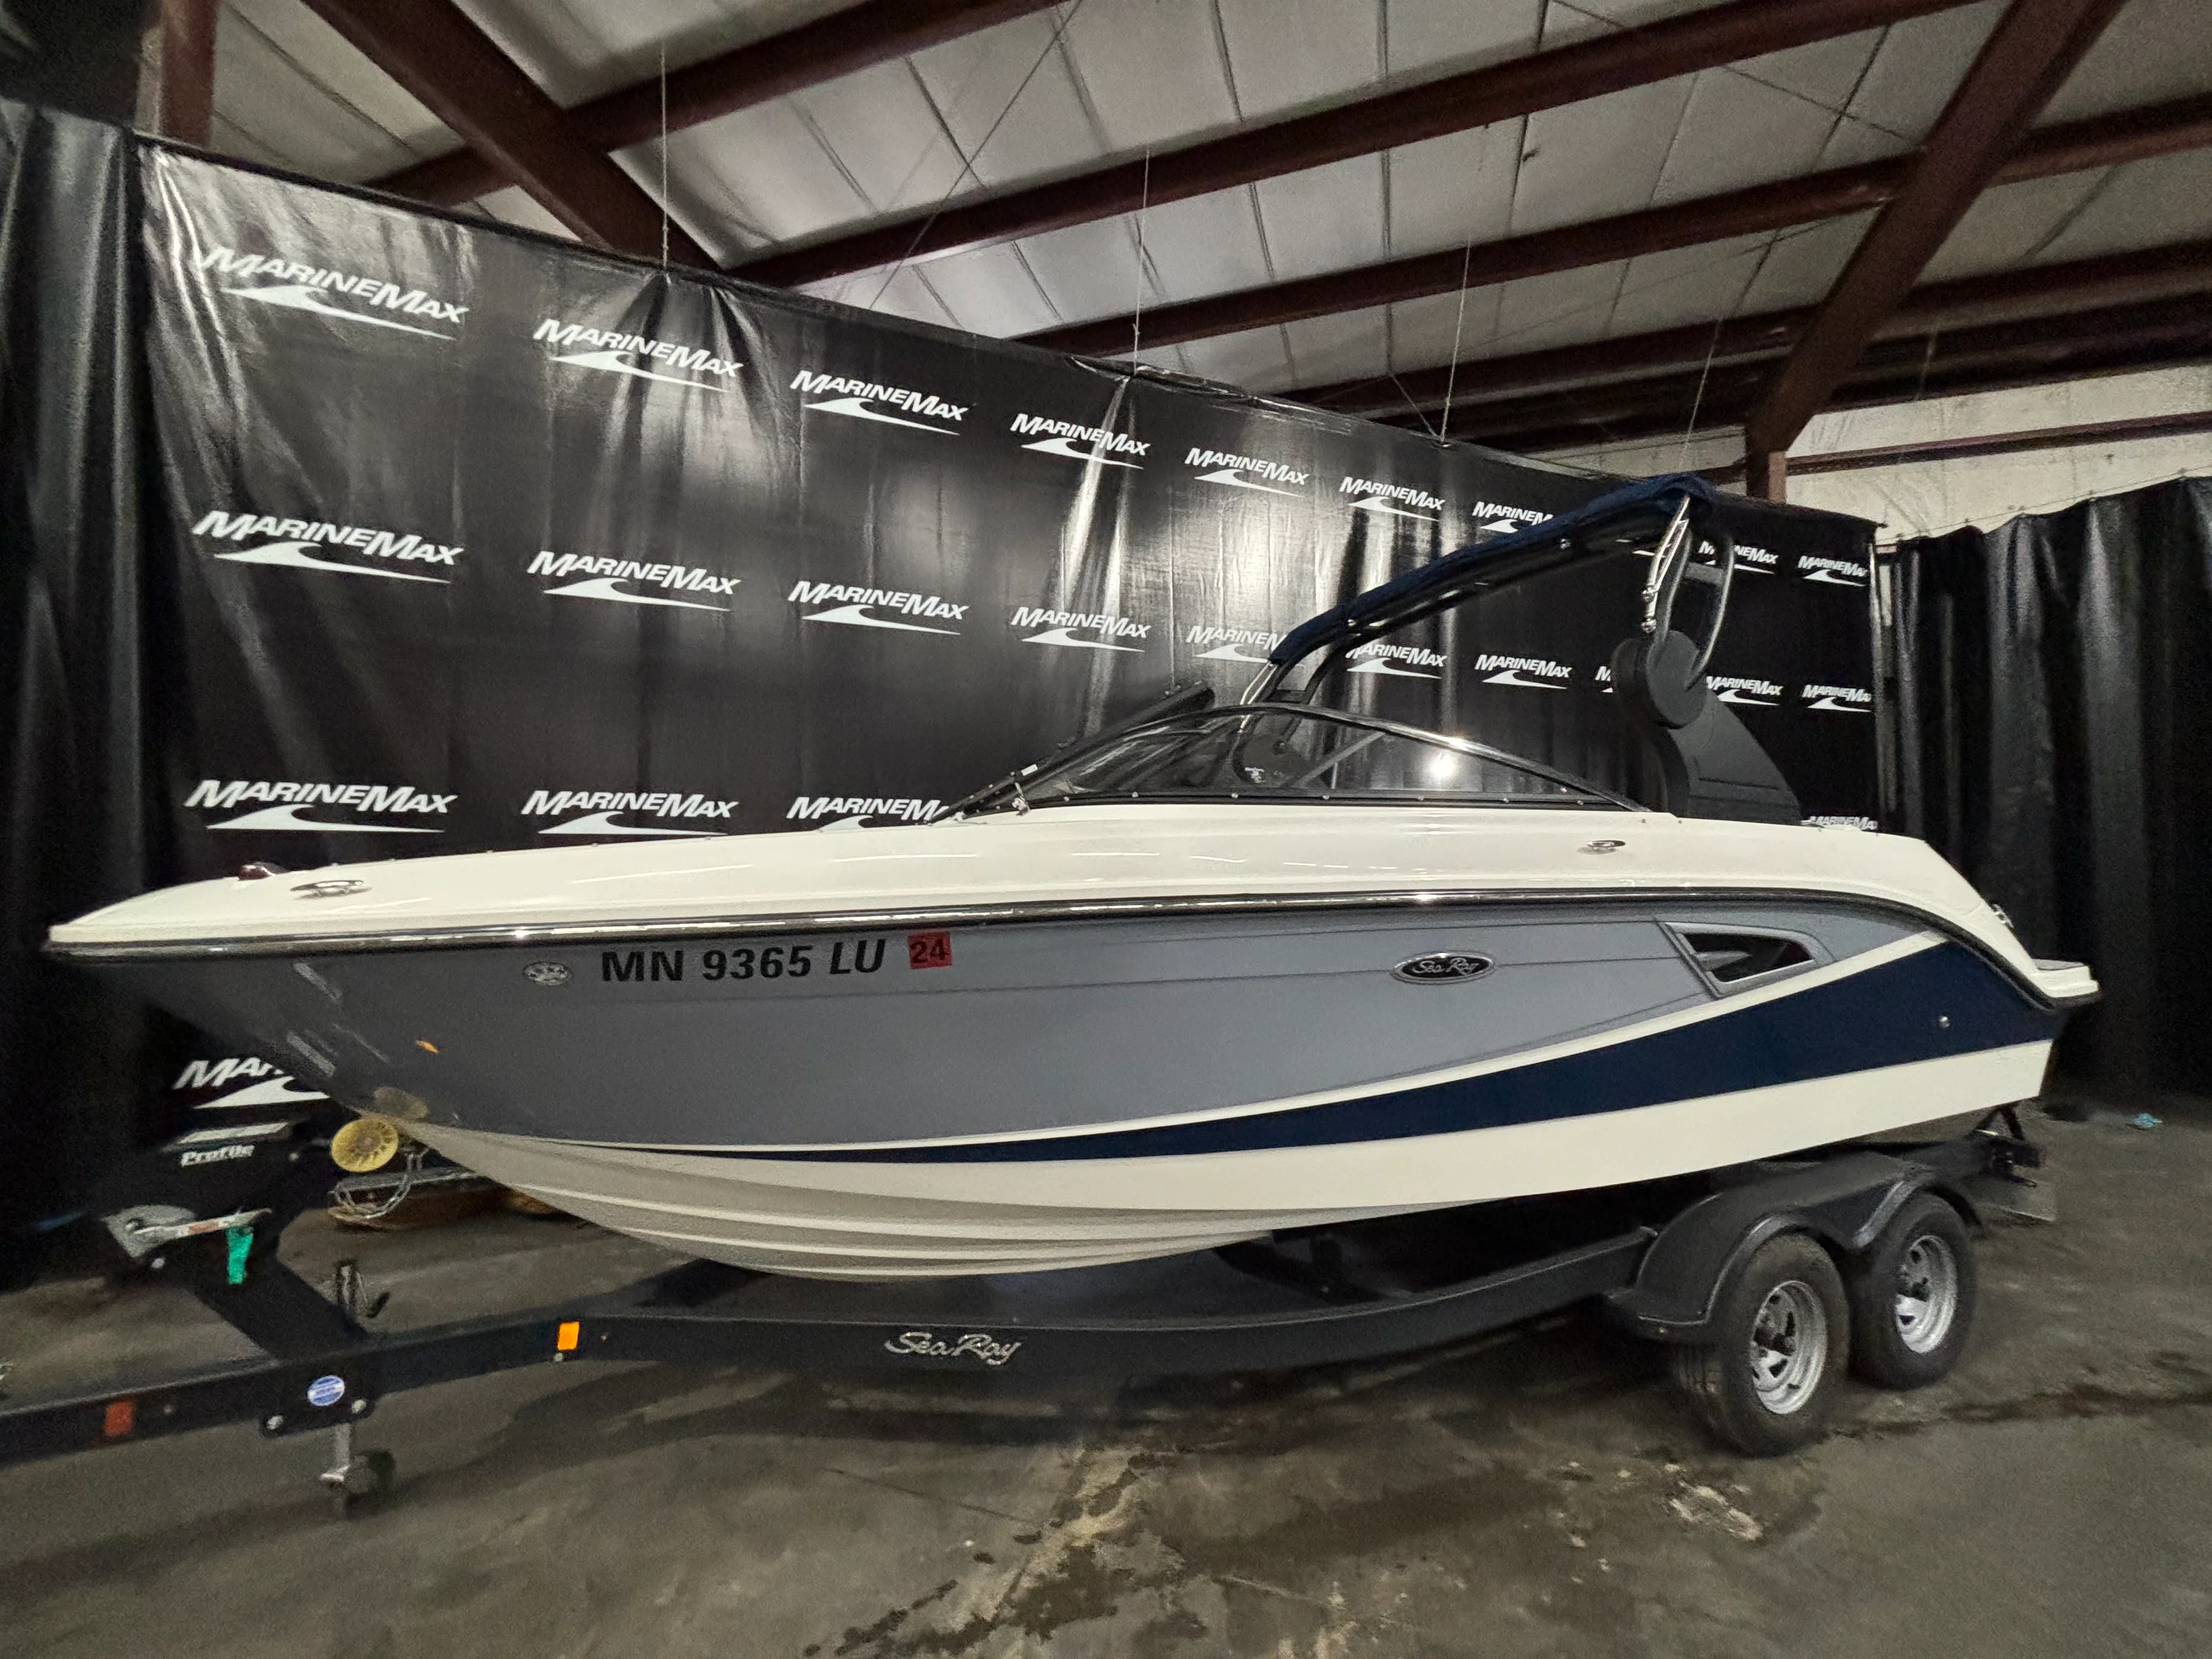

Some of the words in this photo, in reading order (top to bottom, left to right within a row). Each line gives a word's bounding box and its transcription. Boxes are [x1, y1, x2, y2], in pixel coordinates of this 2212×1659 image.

[201, 246, 469, 324] MARINEMAX
[533, 318, 743, 378] MARINEMAX
[790, 370, 970, 422] MARINEMAX
[1010, 413, 1151, 456] MARINEMAX
[1184, 448, 1310, 485] MARINEMAX
[1339, 476, 1446, 511] MARINEMAX
[192, 510, 463, 566] MARINEMAX
[527, 551, 740, 595] MARINEMAX
[788, 580, 970, 621] MARINEMAX
[1011, 606, 1151, 640] MARINEMAX
[1475, 654, 1572, 678] MARINEMAX
[184, 779, 459, 813] MARINEMAX
[521, 790, 740, 819] MARINEMAX
[601, 950, 684, 982] MN
[701, 946, 813, 981] 9365
[830, 939, 886, 975] LU
[910, 939, 945, 963] 24
